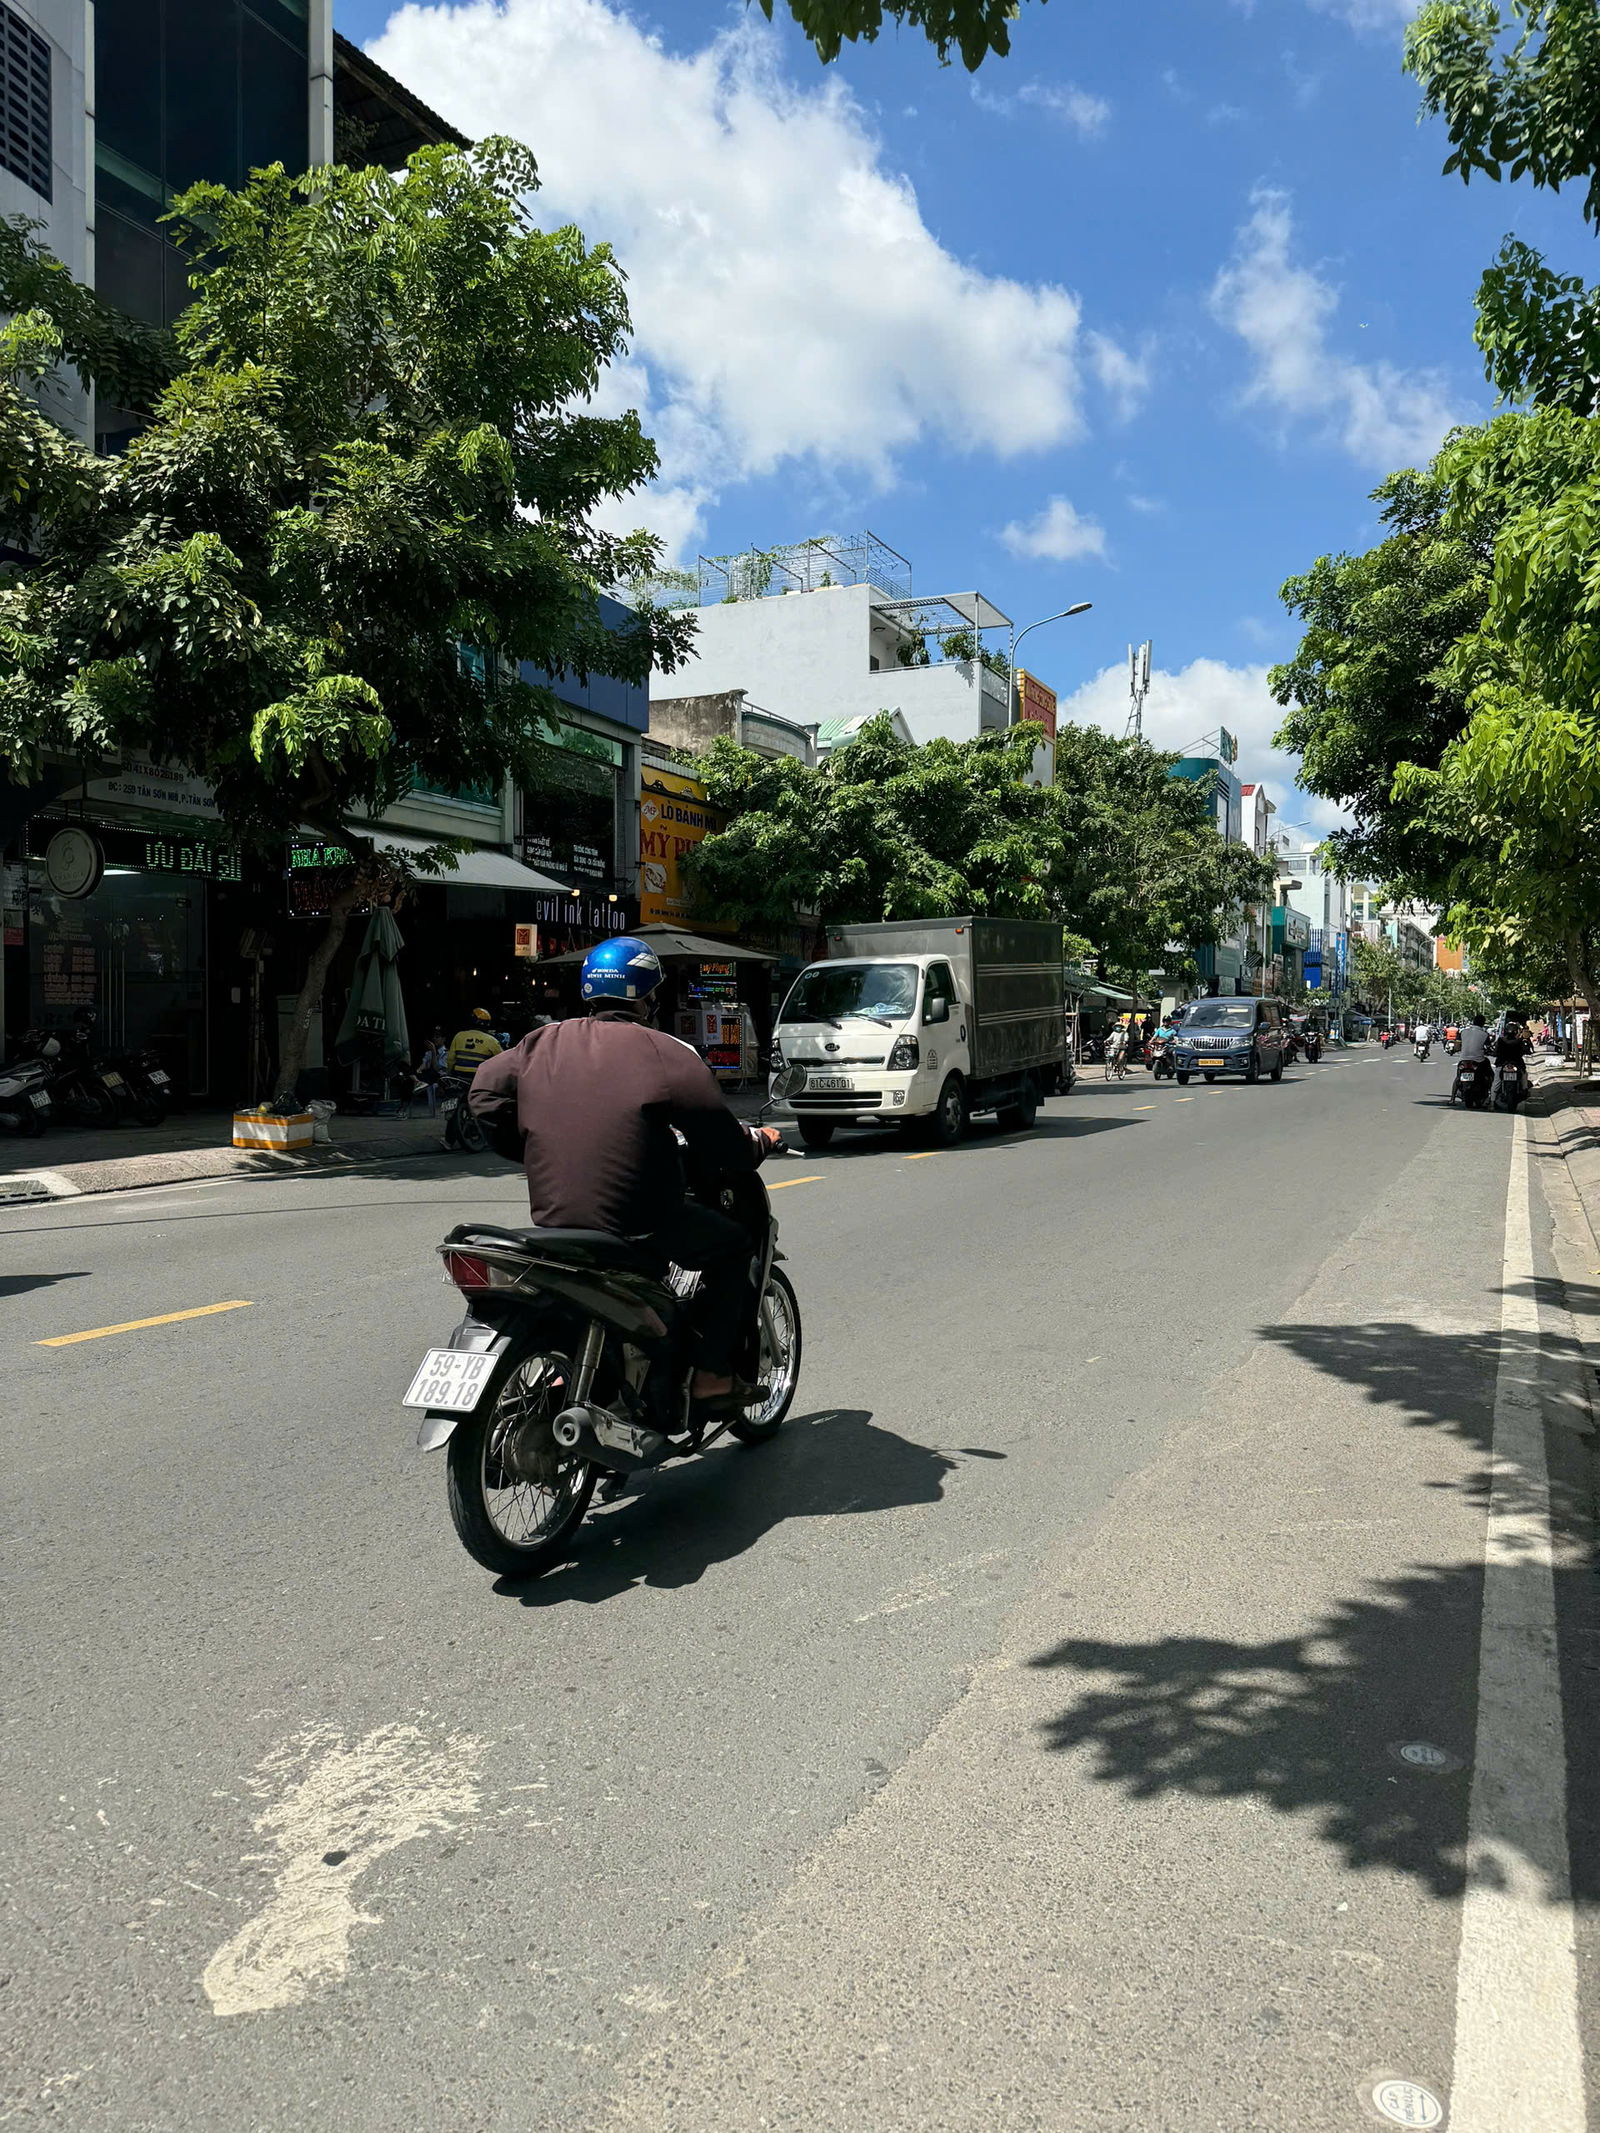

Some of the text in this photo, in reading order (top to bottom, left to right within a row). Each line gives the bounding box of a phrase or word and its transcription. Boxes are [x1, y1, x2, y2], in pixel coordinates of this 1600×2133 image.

[661, 800, 674, 820] LÒ
[676, 804, 703, 828] BÁNH
[536, 895, 559, 923] evil
[564, 898, 582, 926] ink
[588, 900, 626, 931] tattoo
[414, 1378, 479, 1406] 189.18
